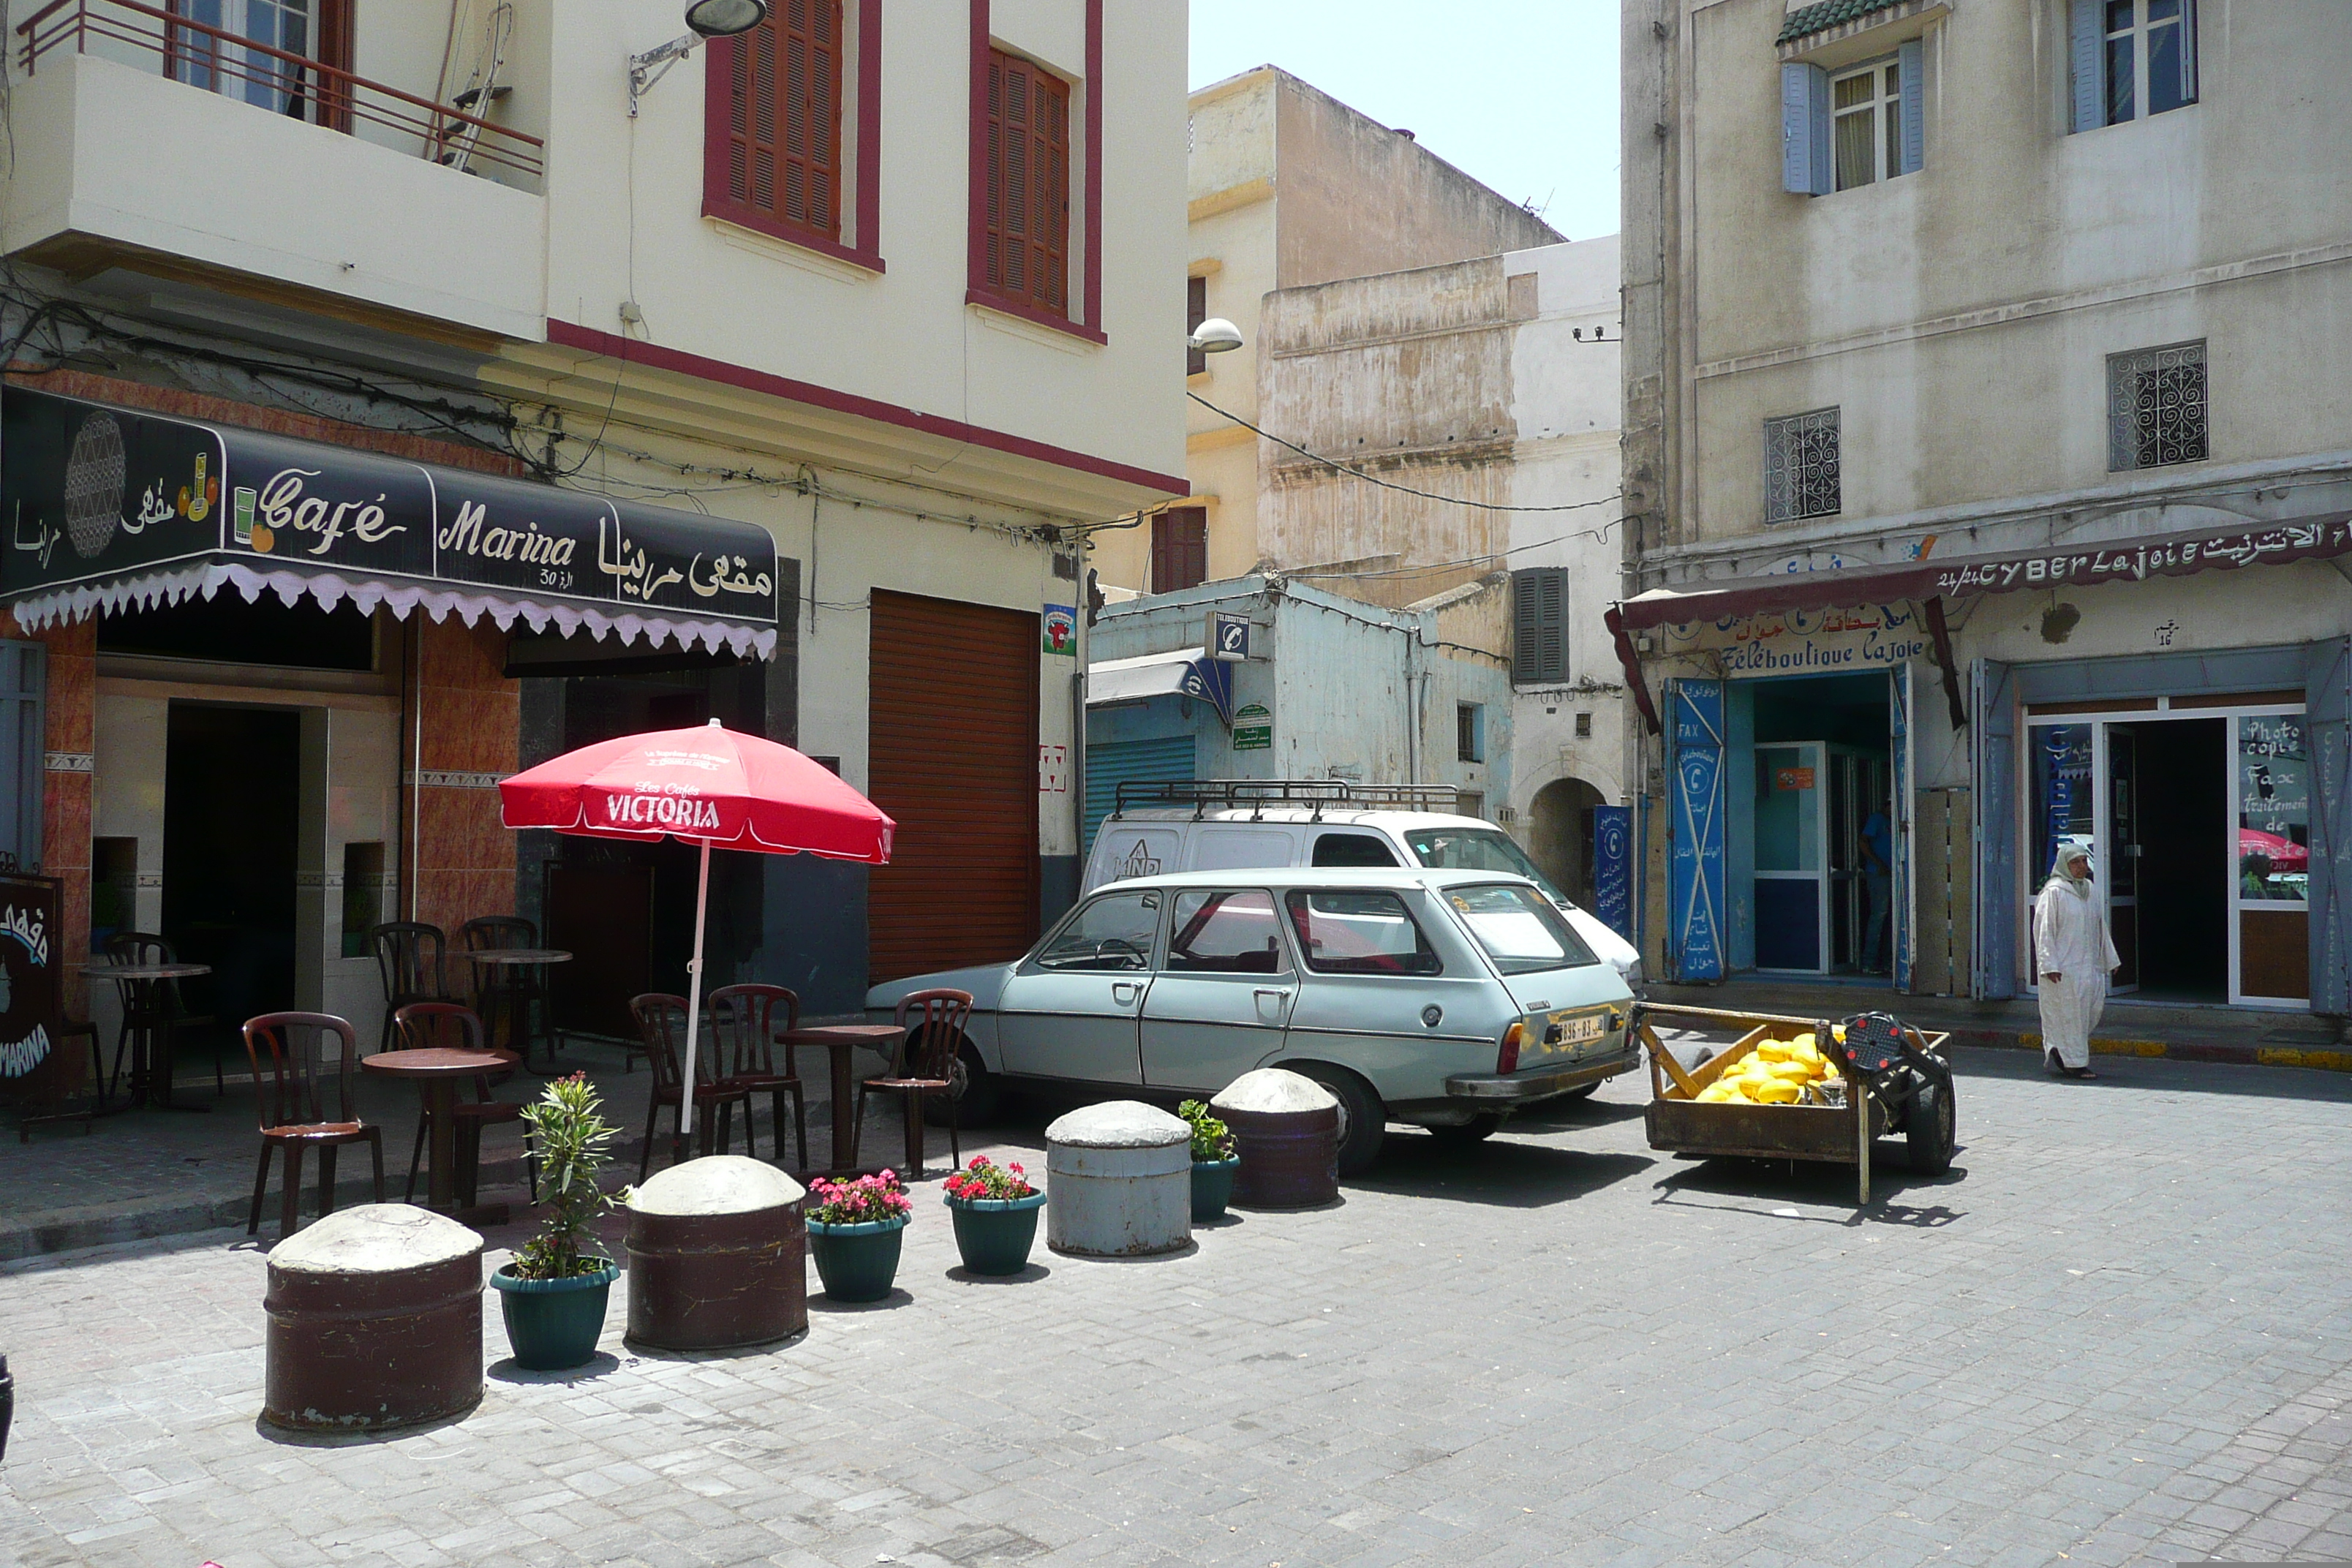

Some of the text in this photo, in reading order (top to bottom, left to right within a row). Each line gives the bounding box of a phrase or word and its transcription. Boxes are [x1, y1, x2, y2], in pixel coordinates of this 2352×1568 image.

[260, 468, 576, 566] Café Marina
[598, 516, 772, 601] مقهى مرينا
[540, 568, 557, 585] 30
[1937, 565, 1980, 596] 24/24
[1678, 723, 1699, 738] FAX
[2247, 721, 2300, 742] Photo
[2246, 738, 2299, 761] copie
[2244, 764, 2295, 785] Fax
[634, 781, 701, 799] Les Cafés
[606, 794, 721, 830] VICTORIA
[2266, 816, 2285, 832] de
